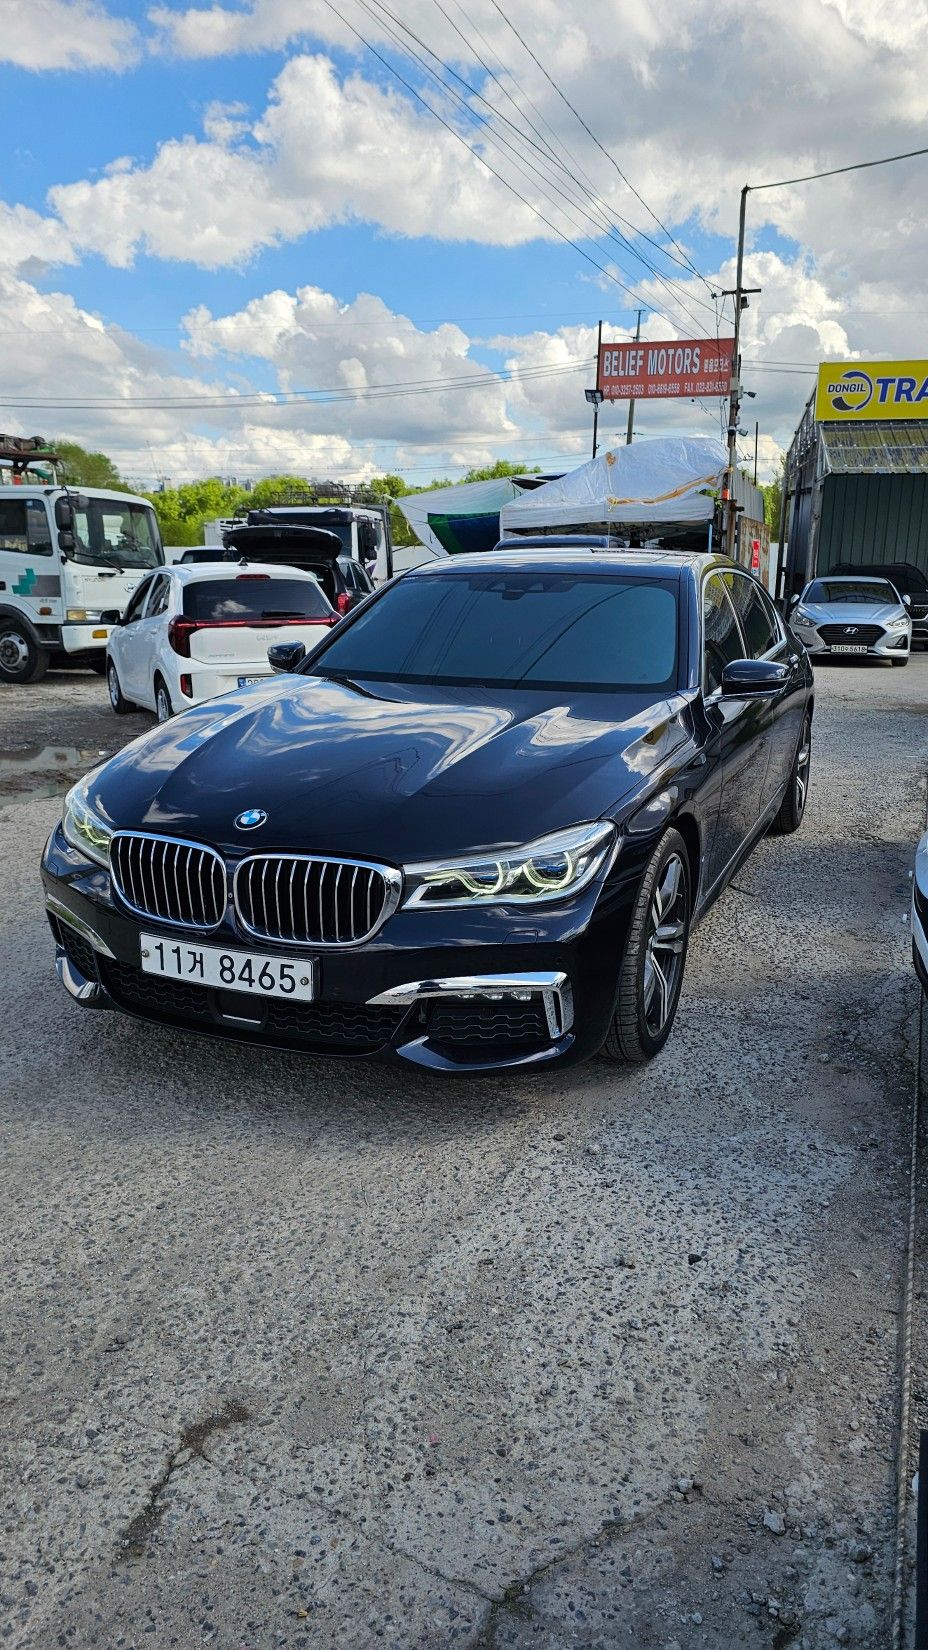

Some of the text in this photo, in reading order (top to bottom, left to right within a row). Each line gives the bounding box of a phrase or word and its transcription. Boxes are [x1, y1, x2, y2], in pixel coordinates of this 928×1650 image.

[603, 347, 701, 377] BELIEF MOTORS
[828, 383, 866, 393] DONGIL
[154, 942, 296, 994] 11거 8465
